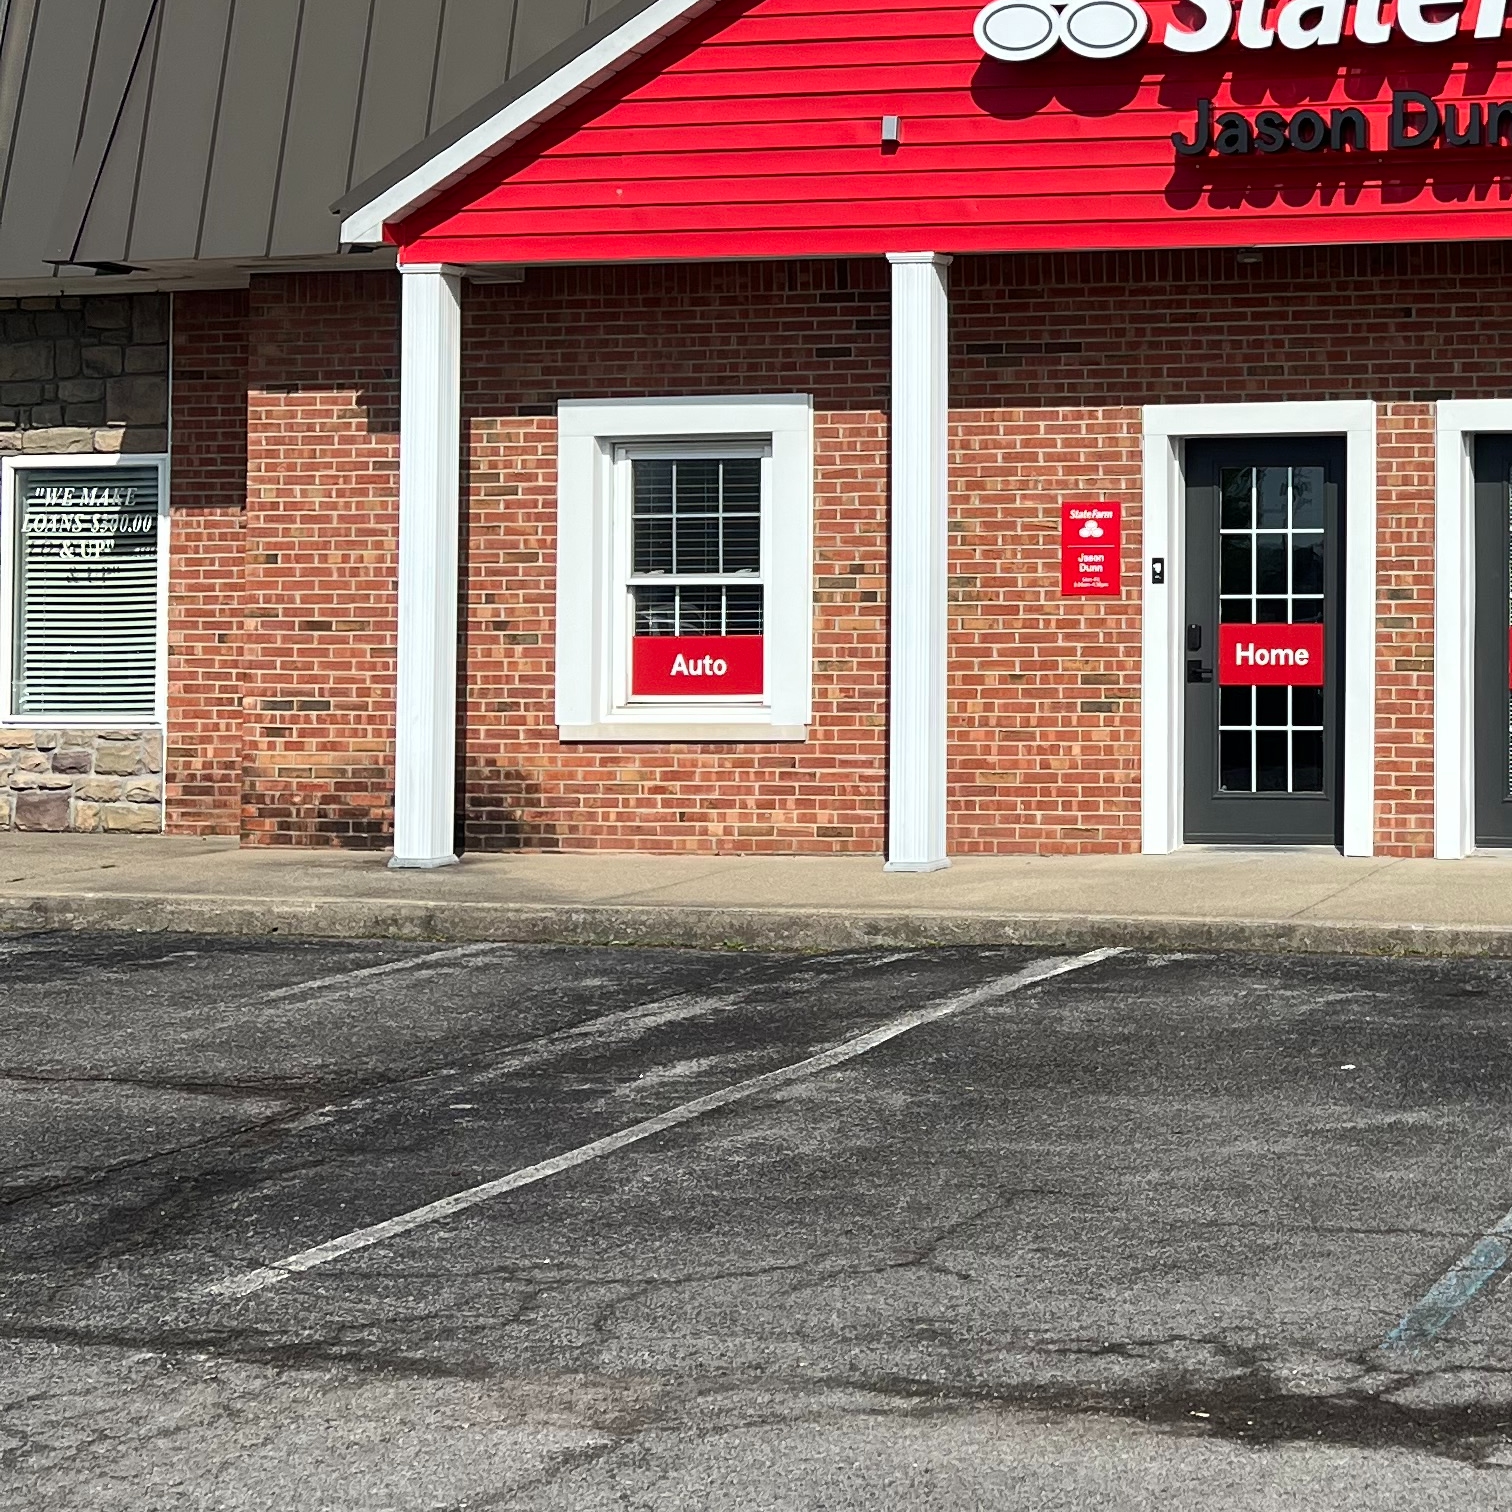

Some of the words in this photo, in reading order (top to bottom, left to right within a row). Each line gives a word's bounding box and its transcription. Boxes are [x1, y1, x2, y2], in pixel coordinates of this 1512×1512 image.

[1171, 98, 1370, 156] Jason
[80, 487, 138, 506] MAKE
[21, 513, 85, 533] LOANS
[1079, 563, 1103, 573] Dunn
[670, 653, 728, 676] Auto
[1236, 642, 1310, 666] Home
